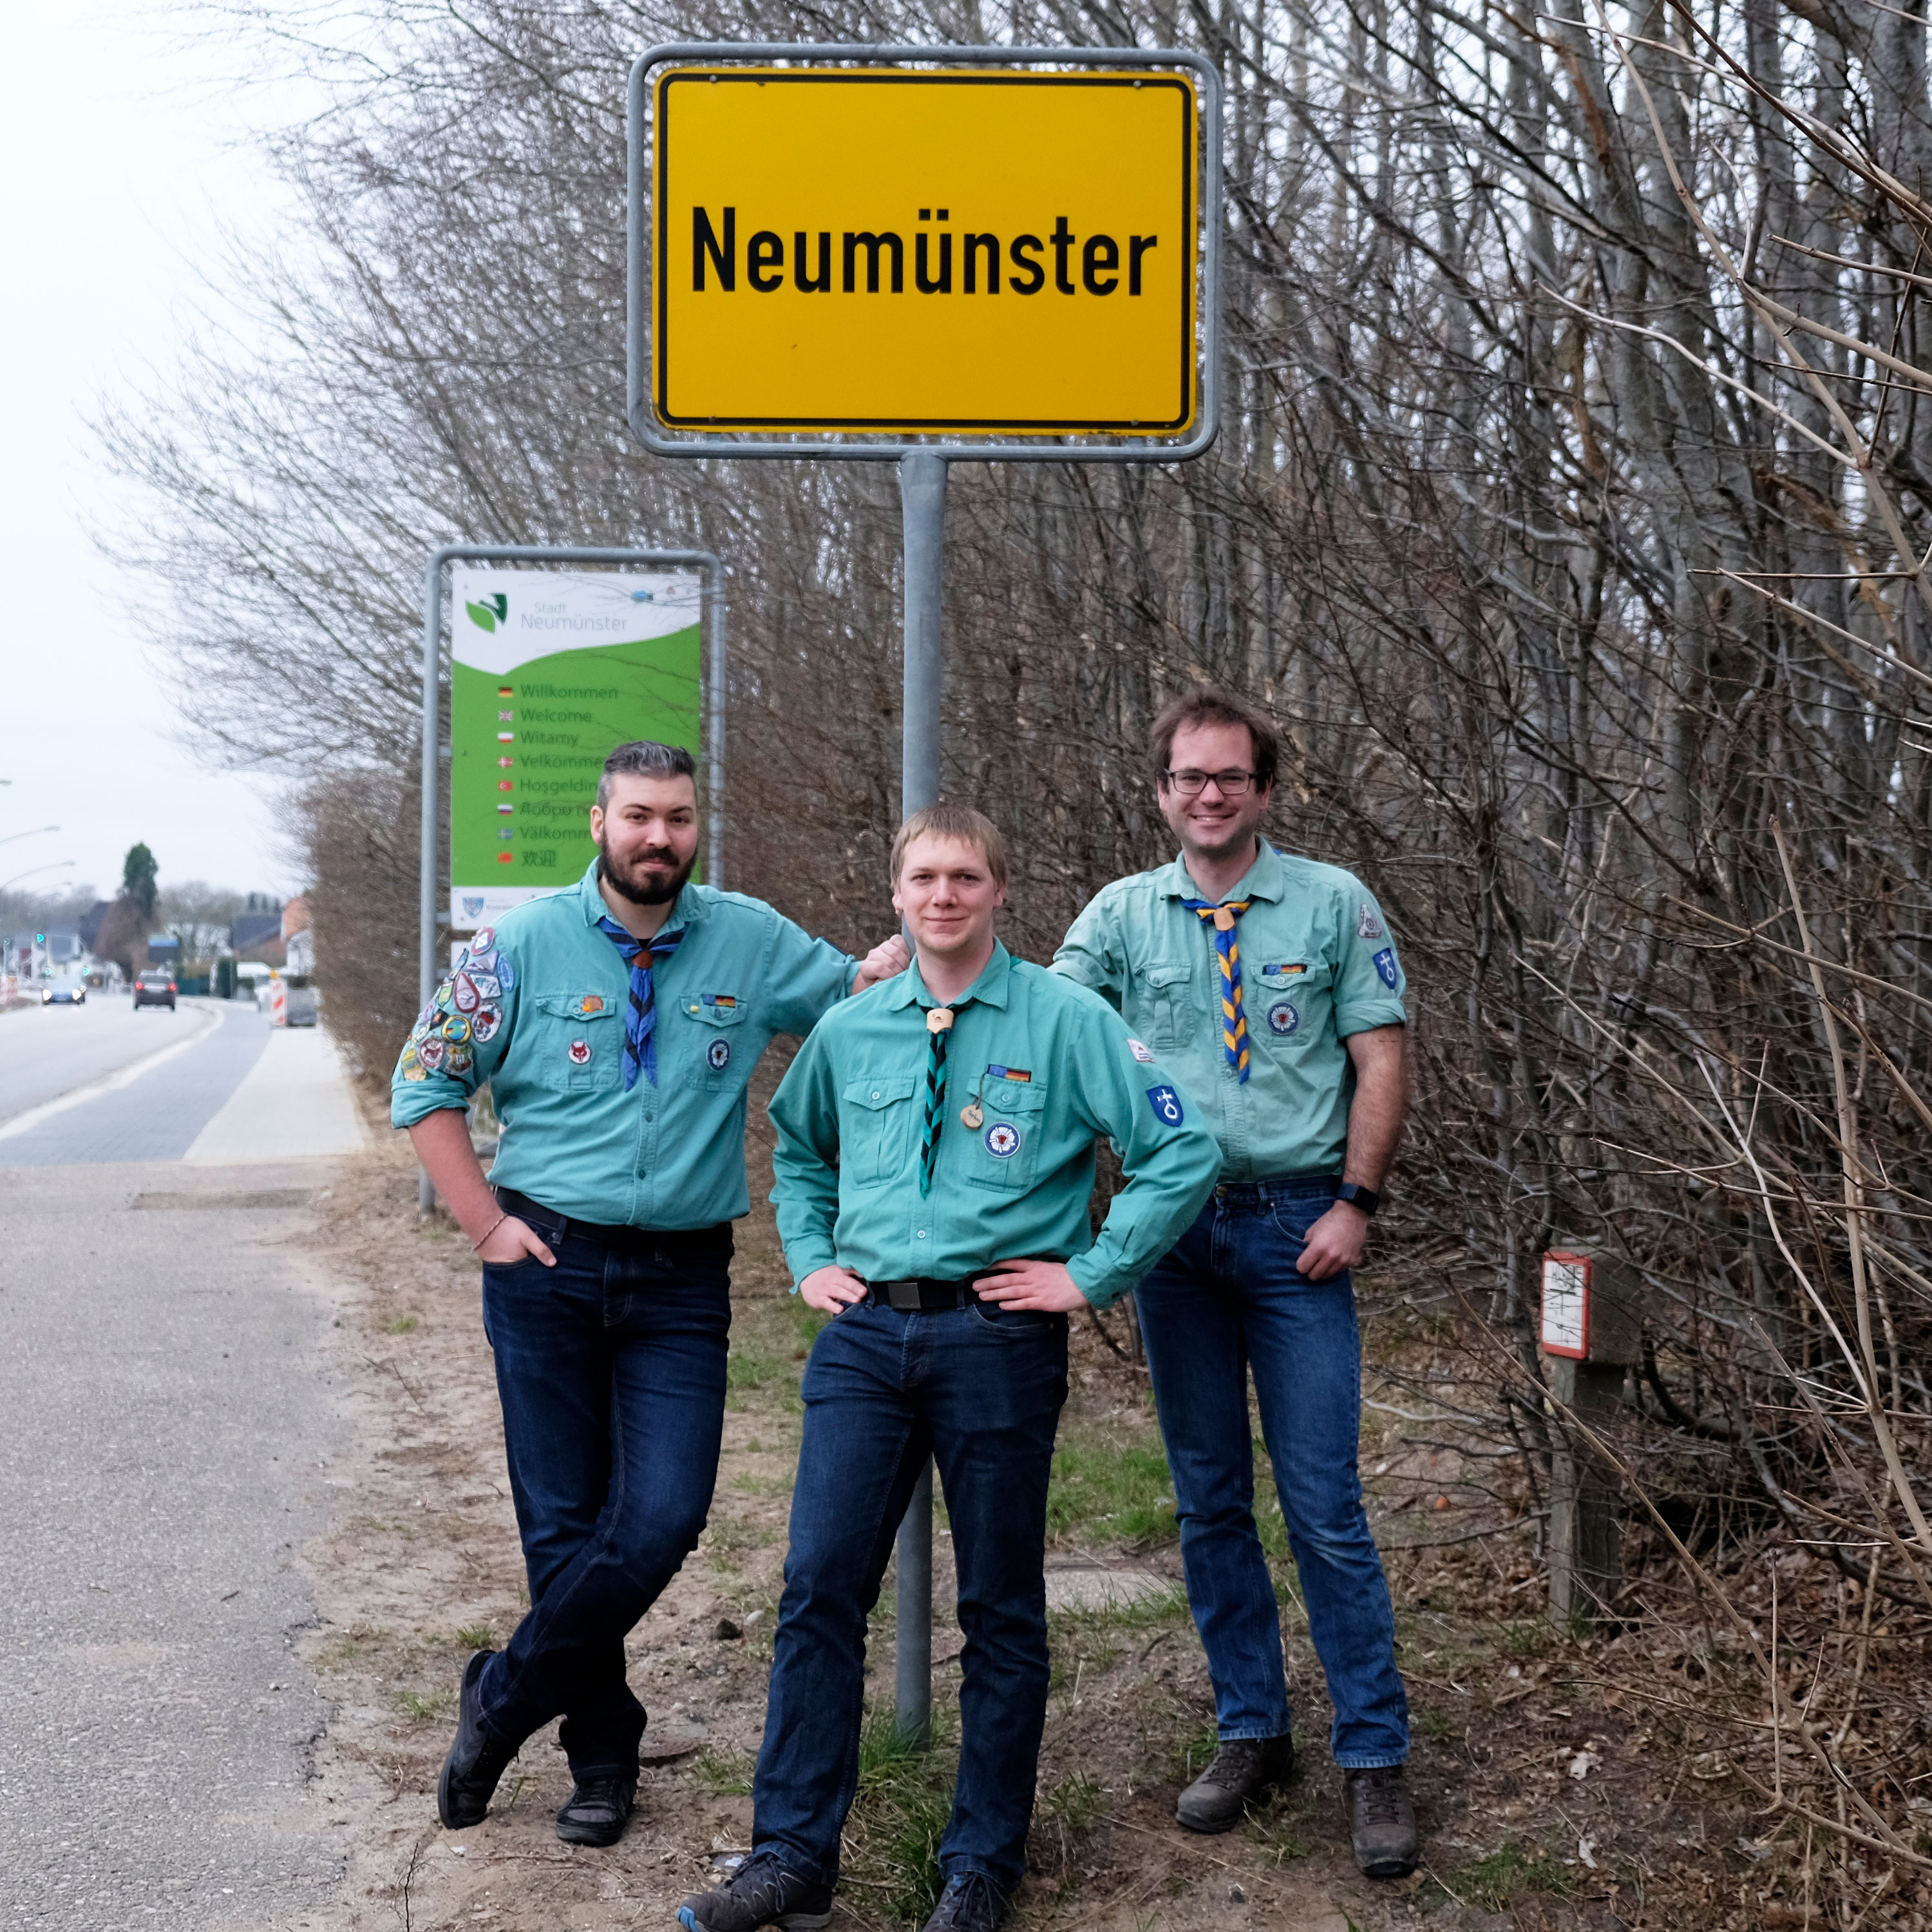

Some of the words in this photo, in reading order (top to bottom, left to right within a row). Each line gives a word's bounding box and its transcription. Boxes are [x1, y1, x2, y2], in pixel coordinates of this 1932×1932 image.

[692, 206, 1157, 296] Neumünster
[534, 601, 567, 614] Stadt
[520, 613, 627, 631] Neumünster
[520, 684, 618, 699] Willkommen
[520, 708, 592, 722] Welcome
[520, 730, 579, 748] Witamy
[520, 754, 604, 768] Velkomme
[520, 778, 598, 795] Hoşgeldin
[520, 824, 592, 840] Välkomm
[522, 850, 556, 867] 欢迎
